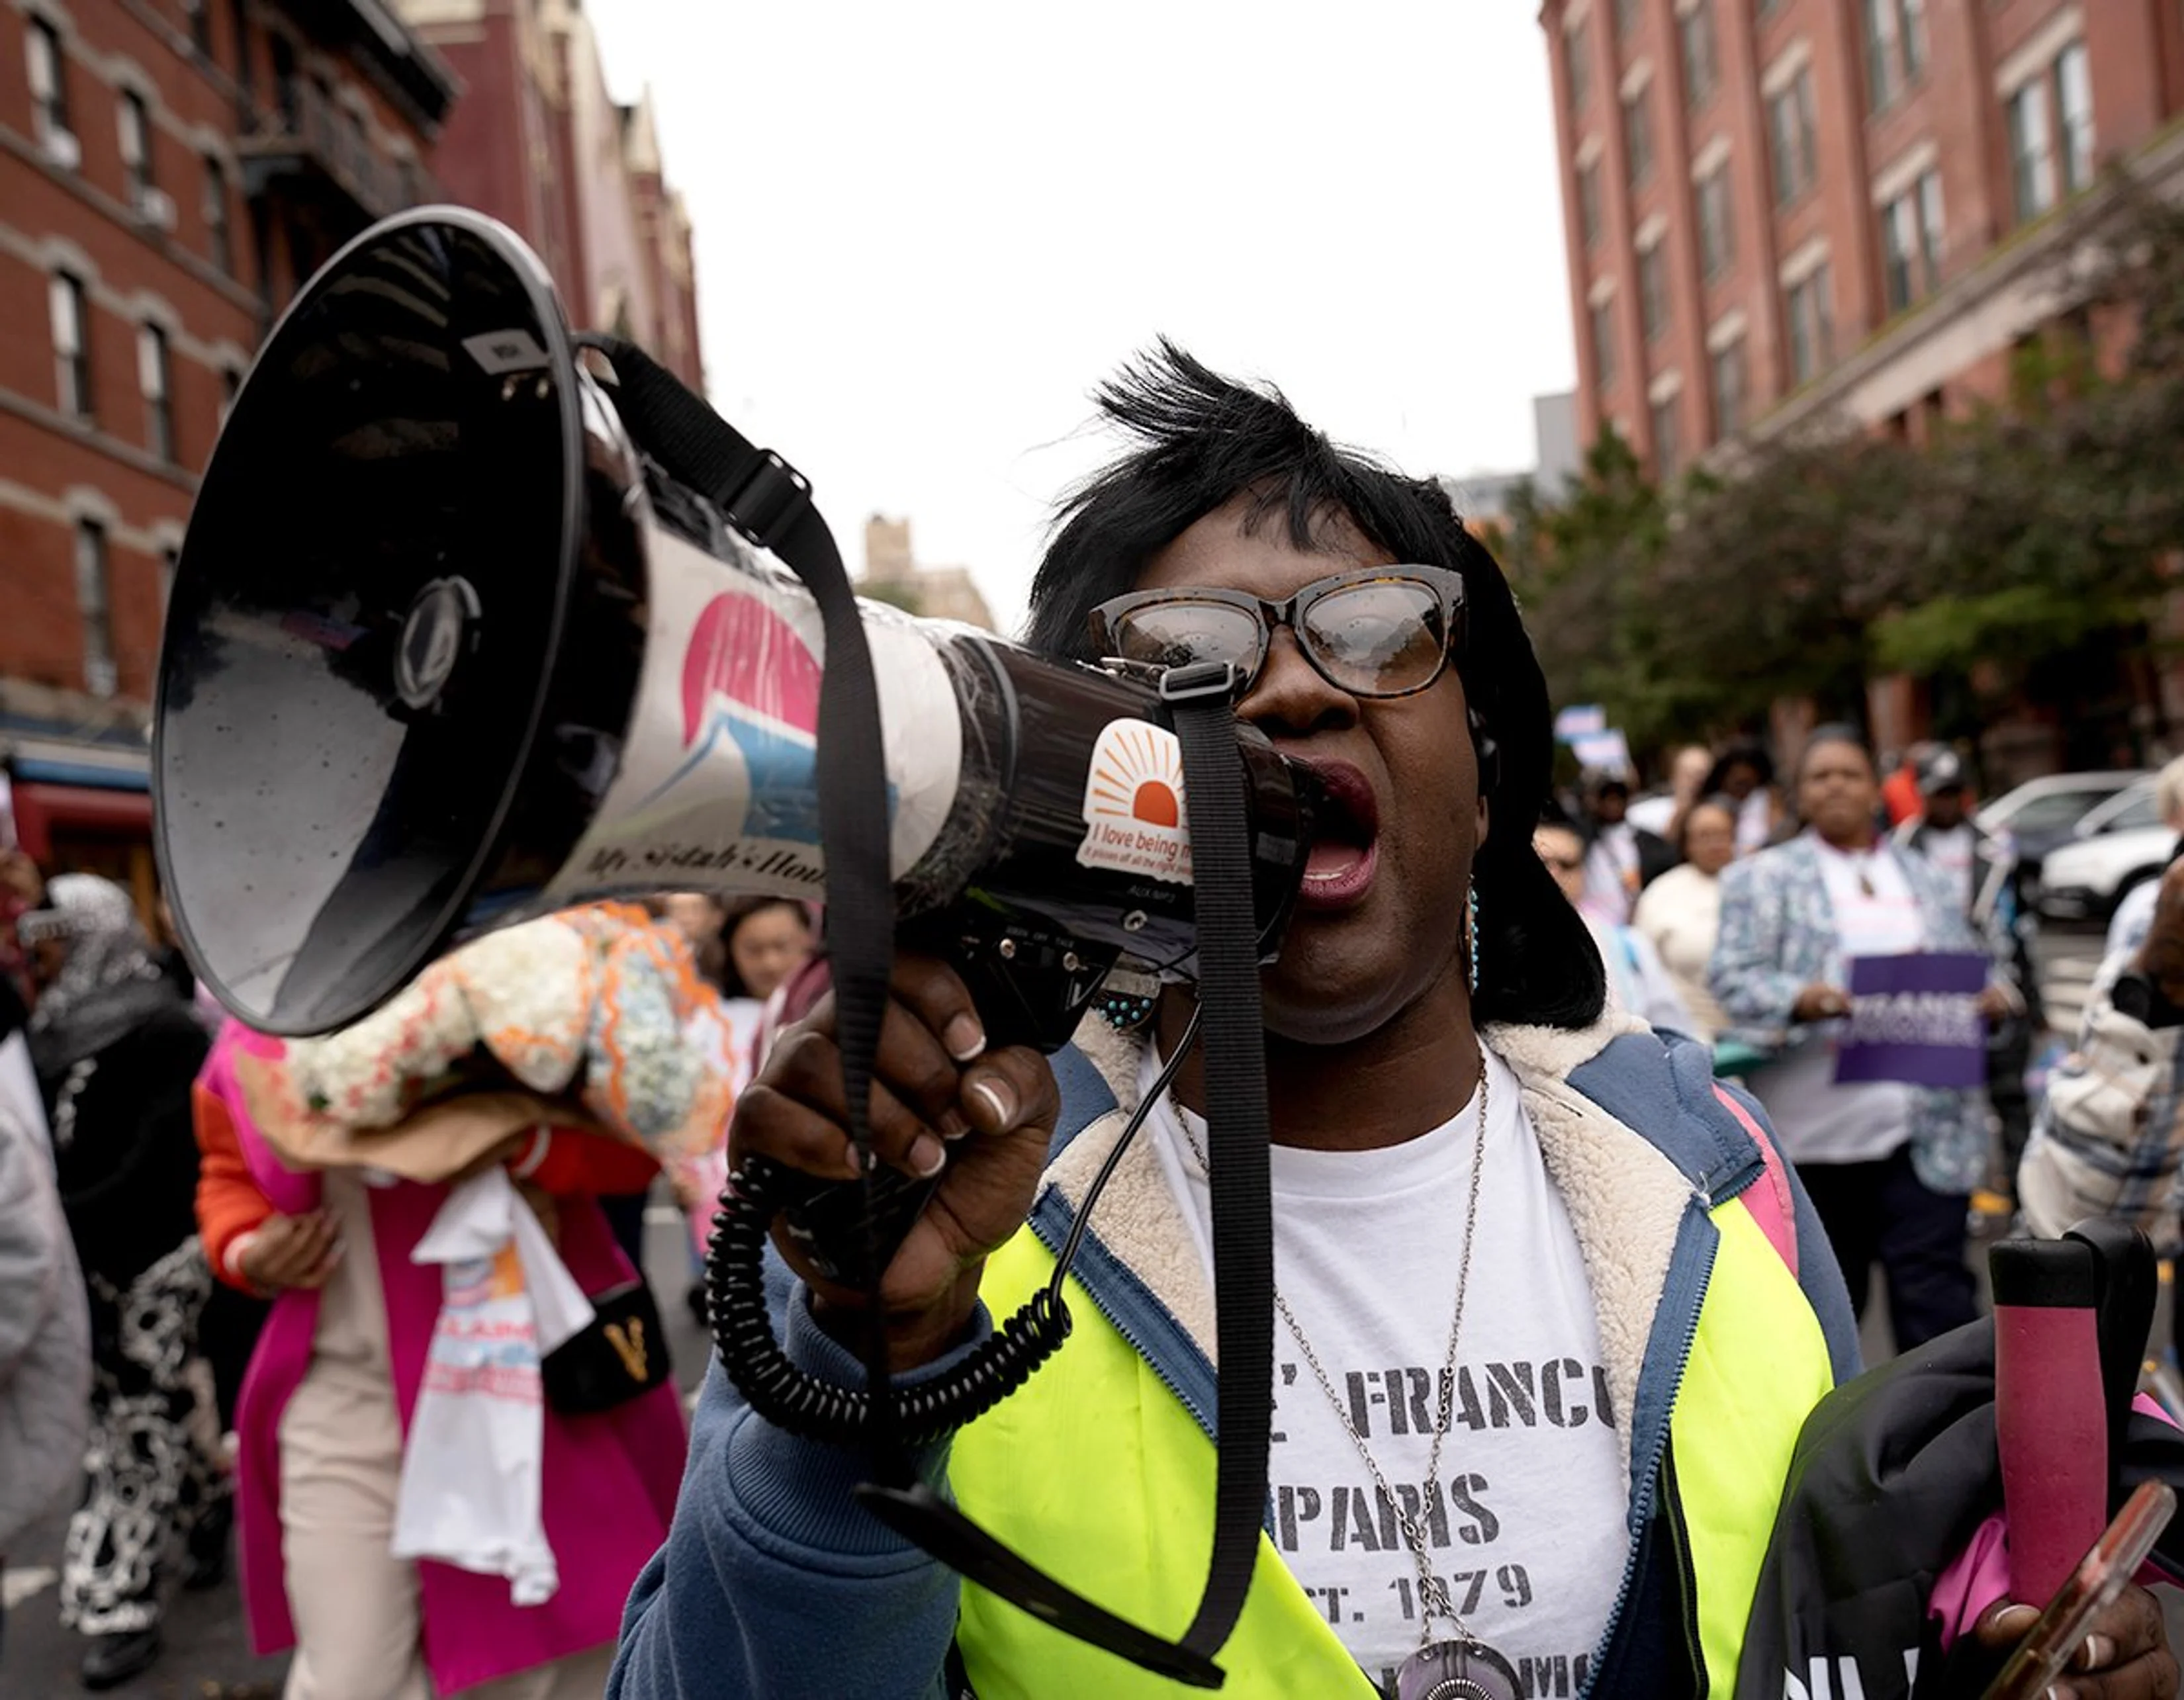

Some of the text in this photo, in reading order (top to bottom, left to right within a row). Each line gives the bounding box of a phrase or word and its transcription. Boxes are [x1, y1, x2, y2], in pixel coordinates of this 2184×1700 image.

[1093, 822, 1101, 841] I
[1101, 823, 1134, 848] love
[1136, 830, 1179, 862] being
[756, 850, 825, 883] Hou
[1278, 1472, 1500, 1552] PARIS
